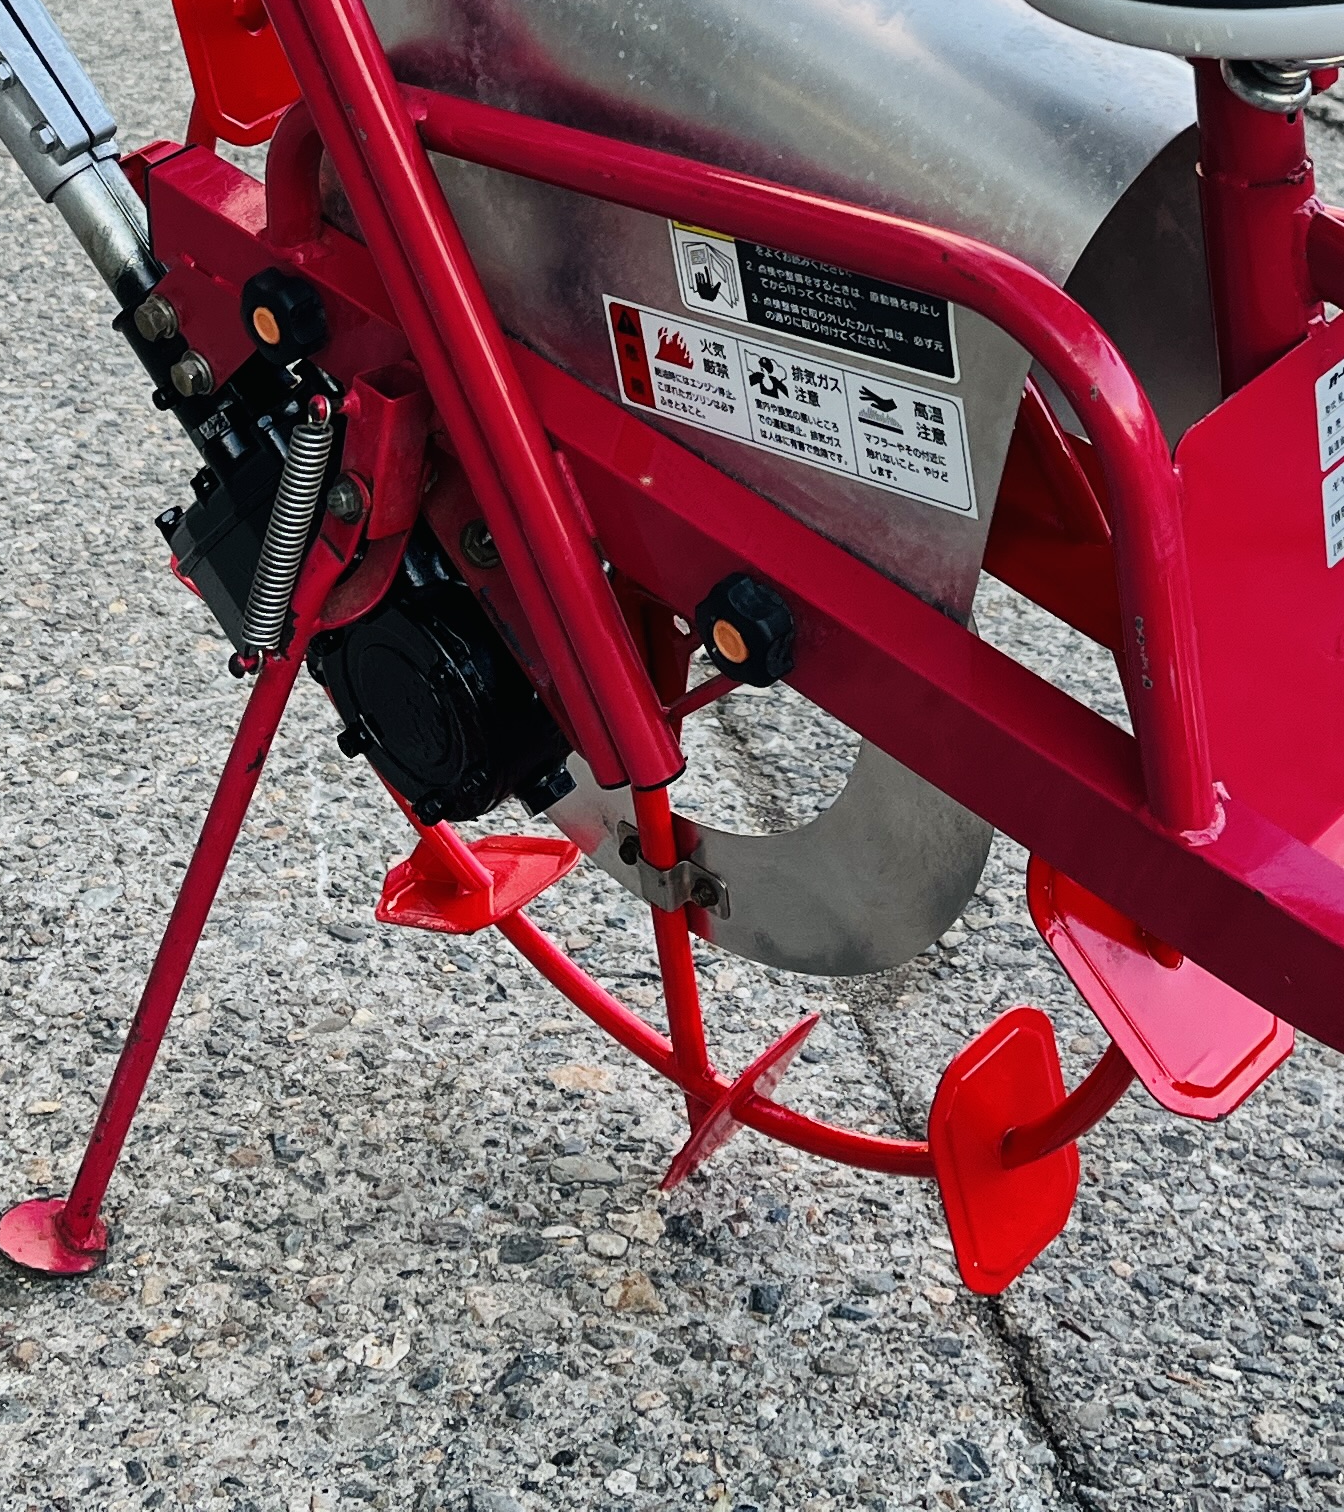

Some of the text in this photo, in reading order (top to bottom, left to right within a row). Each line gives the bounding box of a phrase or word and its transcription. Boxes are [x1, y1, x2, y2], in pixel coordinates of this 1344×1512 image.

[698, 336, 727, 360] 火気
[789, 363, 842, 395] 排気ガス
[793, 384, 821, 409] 注意
[911, 399, 945, 425] 高温
[914, 421, 948, 448] 注意
[862, 430, 947, 468] マフラーやその付近に
[868, 462, 898, 483] します。
